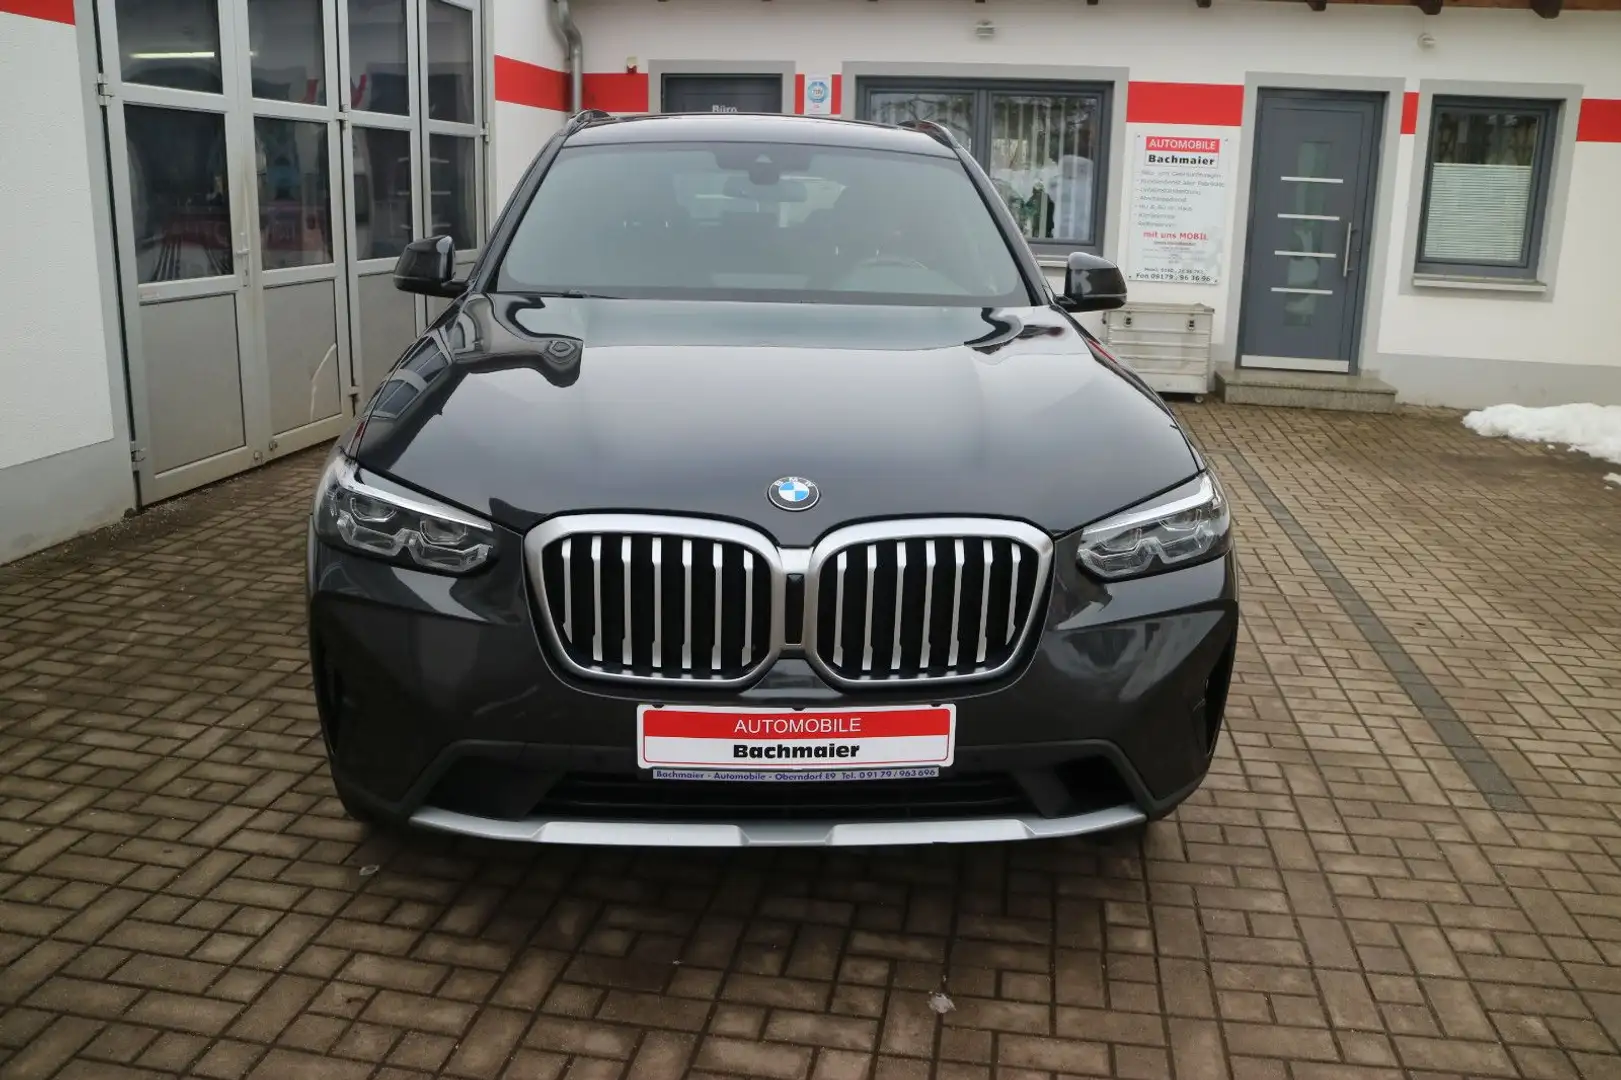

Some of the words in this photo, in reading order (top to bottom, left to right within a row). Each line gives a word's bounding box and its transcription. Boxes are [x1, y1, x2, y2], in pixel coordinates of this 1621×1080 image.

[712, 104, 738, 113] Büro
[1148, 138, 1216, 149] AUTOMOBILE
[1148, 154, 1215, 165] Bachmaier
[1179, 232, 1209, 241] MOBIL
[734, 718, 861, 734] AUTOMOBILE
[733, 743, 860, 758] Bachmaier
[656, 770, 704, 779] Bachmaier
[713, 772, 766, 780] Automobile
[774, 772, 823, 781] Oberndorf
